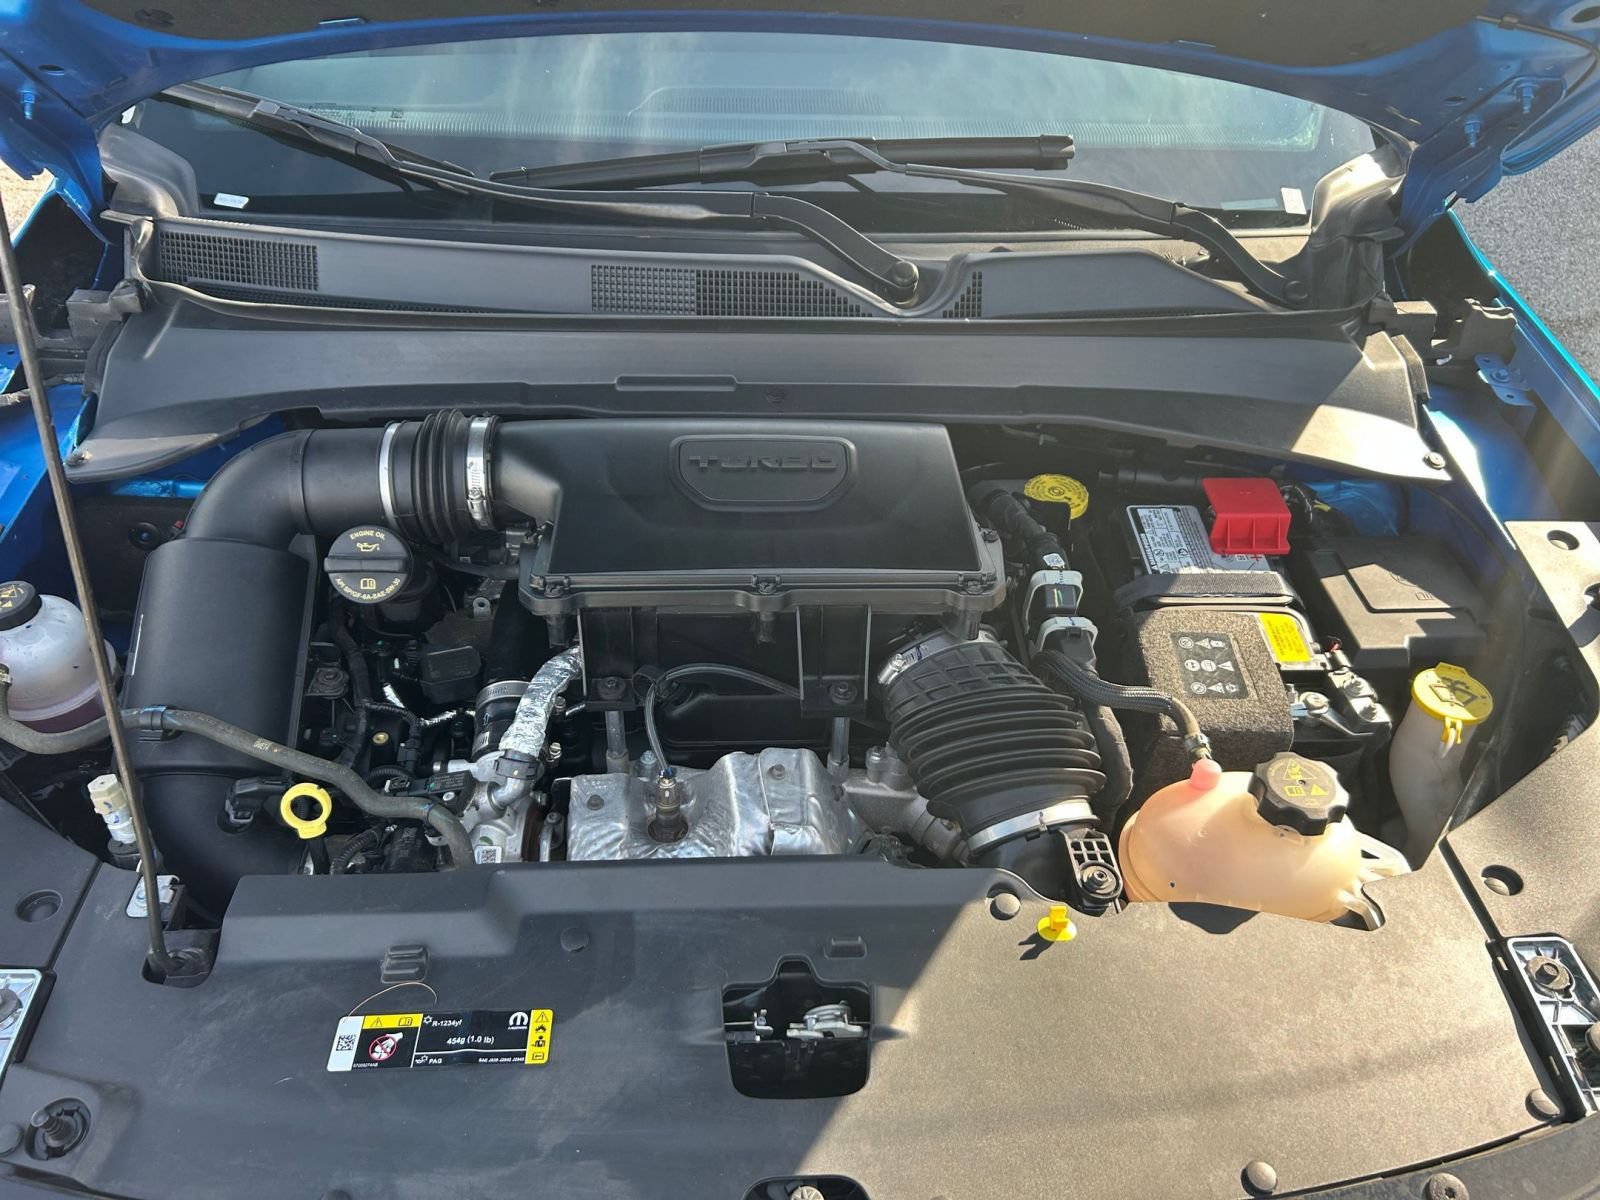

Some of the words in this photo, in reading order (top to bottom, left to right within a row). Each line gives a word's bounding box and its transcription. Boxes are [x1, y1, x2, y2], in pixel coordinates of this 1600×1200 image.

[688, 456, 839, 469] TURBO
[350, 530, 374, 540] ENGINE
[375, 531, 385, 540] OIL
[335, 578, 345, 588] API
[432, 1019, 463, 1028] R-1234yf
[446, 1037, 466, 1046] 454g
[467, 1034, 482, 1044] (1.0
[484, 1036, 494, 1046] lb)
[428, 1057, 443, 1065] PAG
